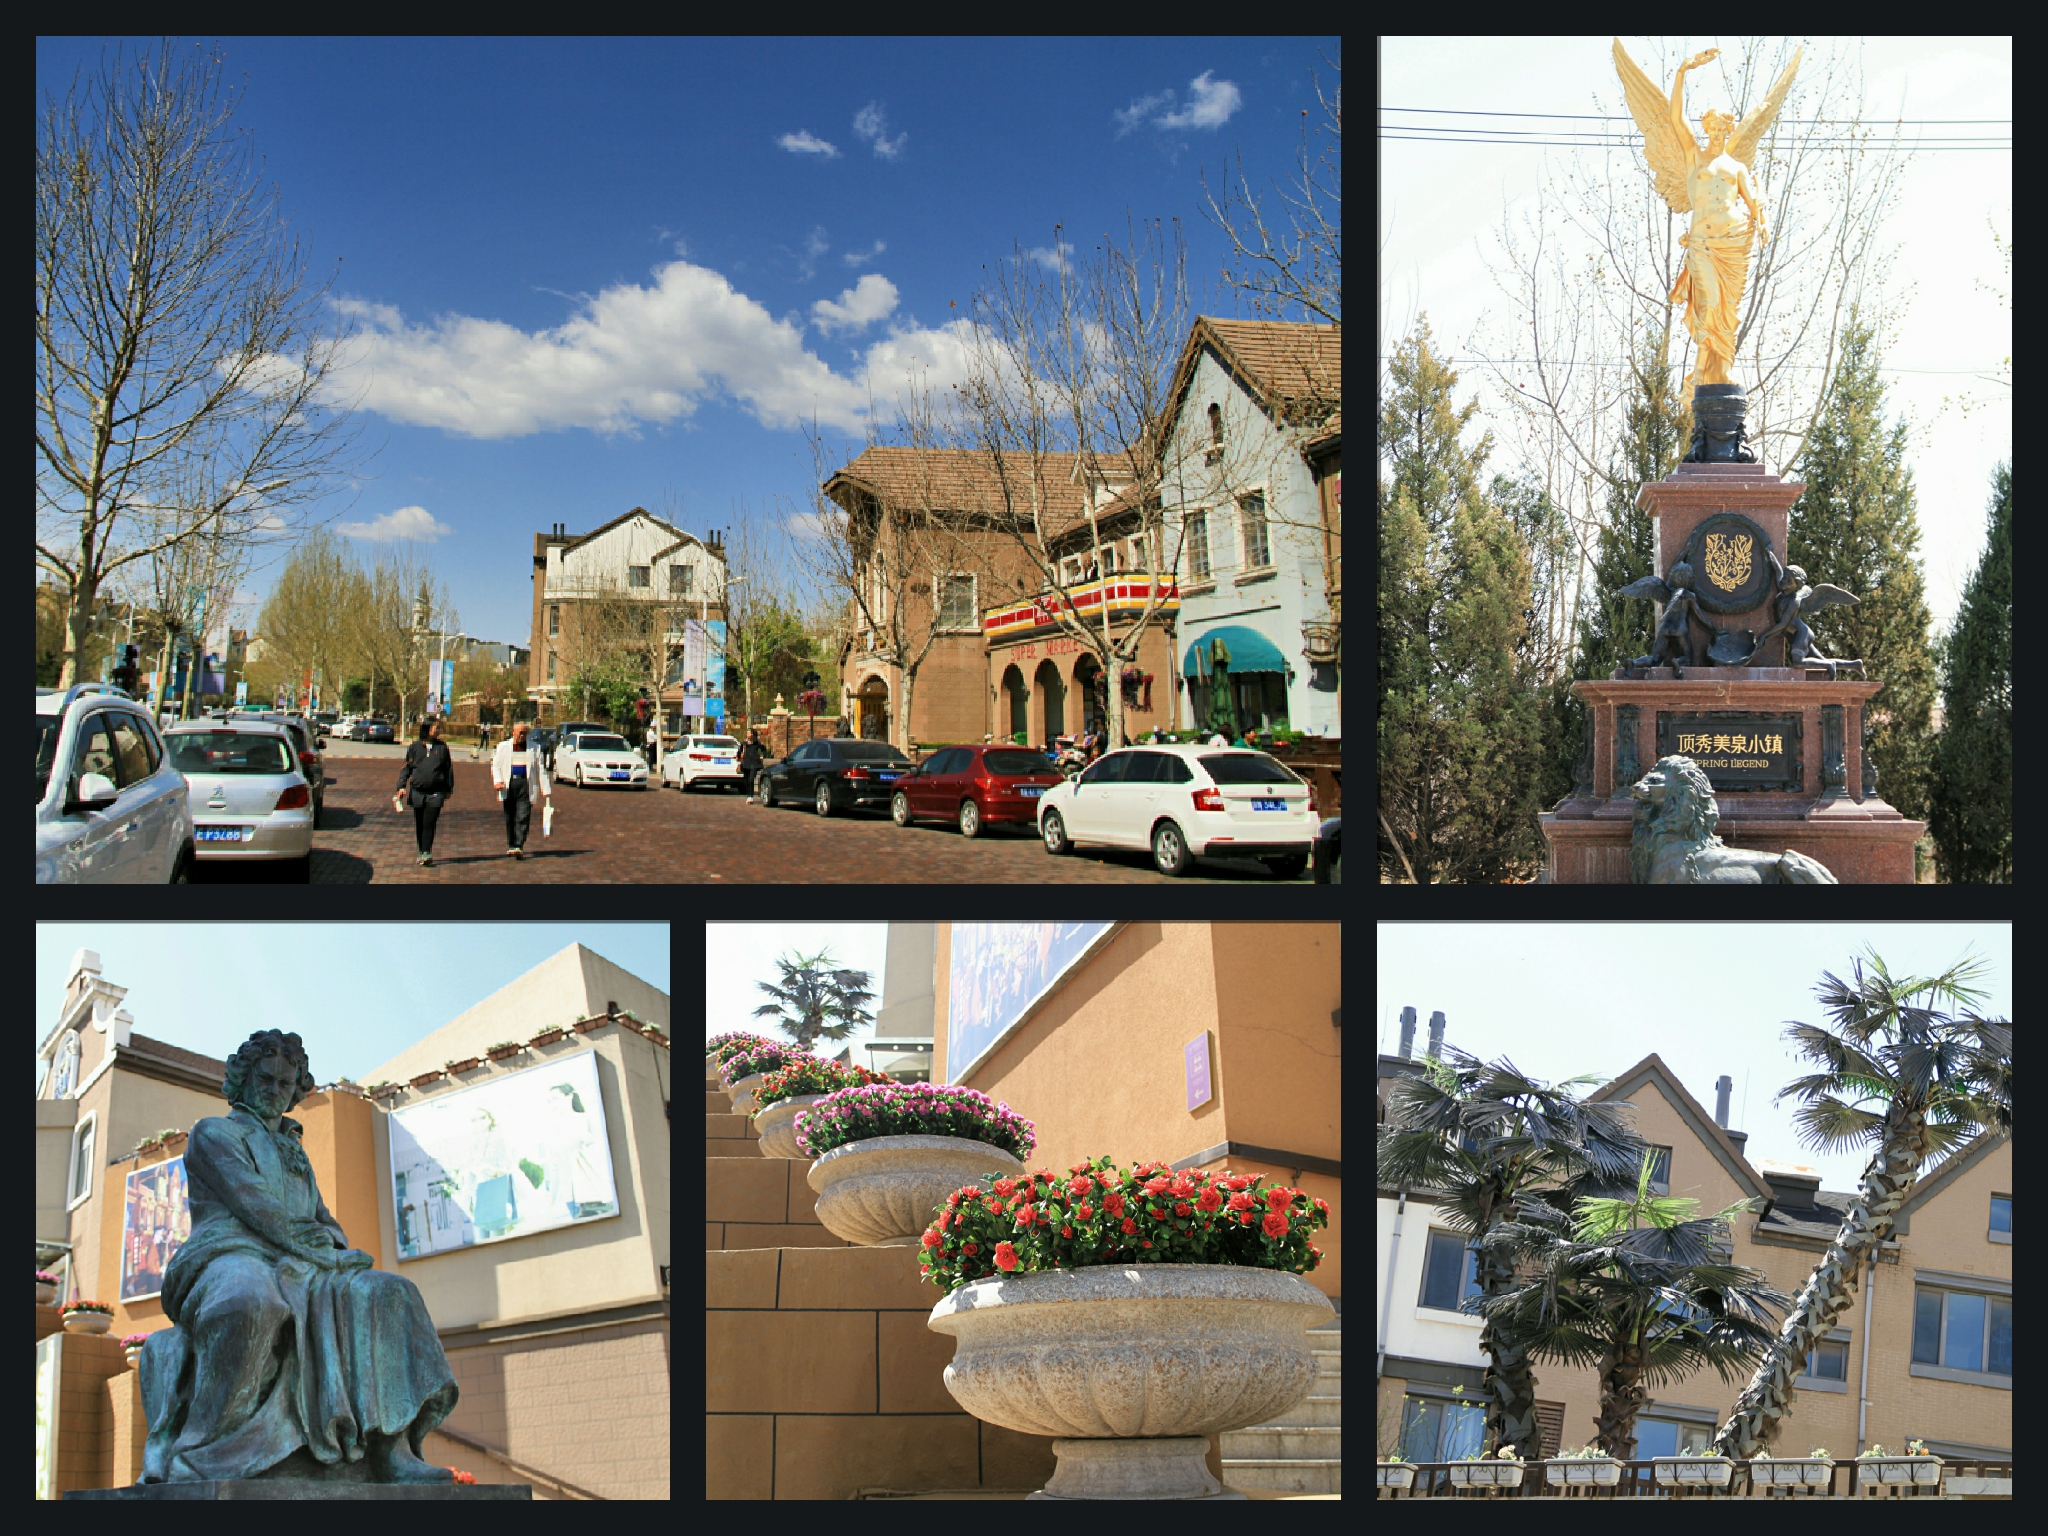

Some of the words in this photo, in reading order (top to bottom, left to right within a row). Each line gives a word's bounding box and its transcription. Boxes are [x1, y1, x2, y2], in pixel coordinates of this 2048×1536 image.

[1677, 734, 1783, 754] 顶秀美泉小镇
[1730, 759, 1769, 768] LEGEND
